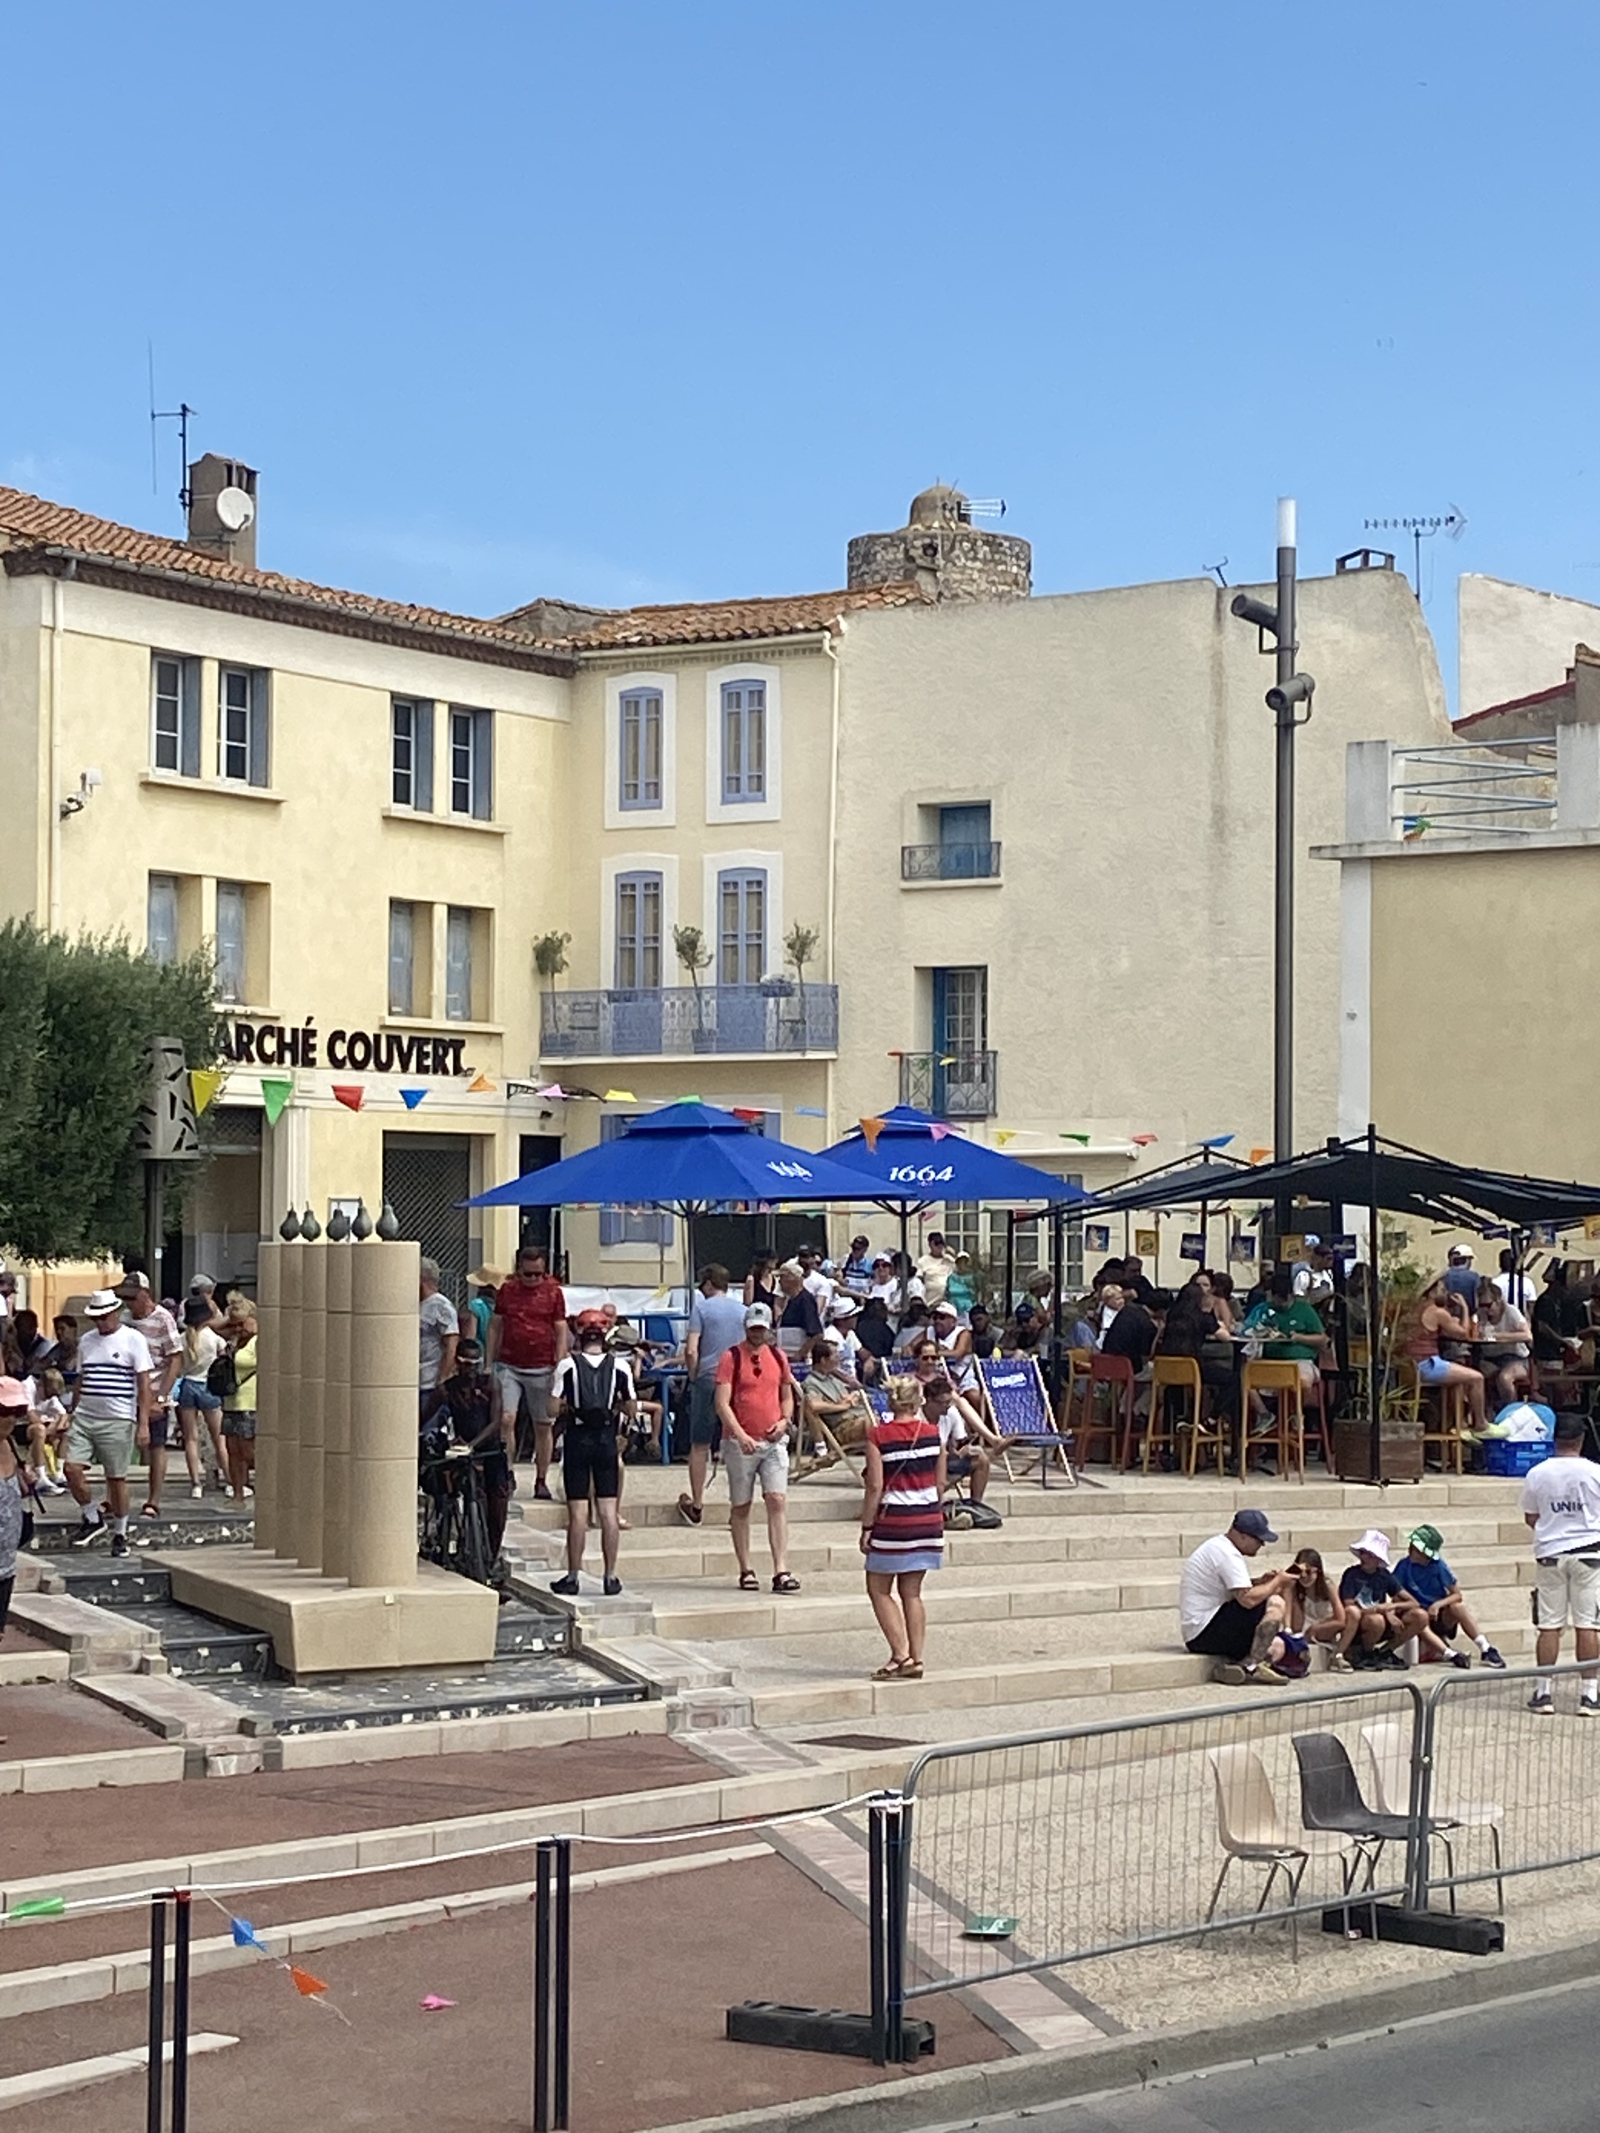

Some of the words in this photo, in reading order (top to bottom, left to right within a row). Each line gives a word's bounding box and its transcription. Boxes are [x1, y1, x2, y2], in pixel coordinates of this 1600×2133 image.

[211, 1016, 317, 1068] ARCHÉ
[327, 1030, 466, 1076] COUVERT
[889, 1165, 955, 1182] 1664
